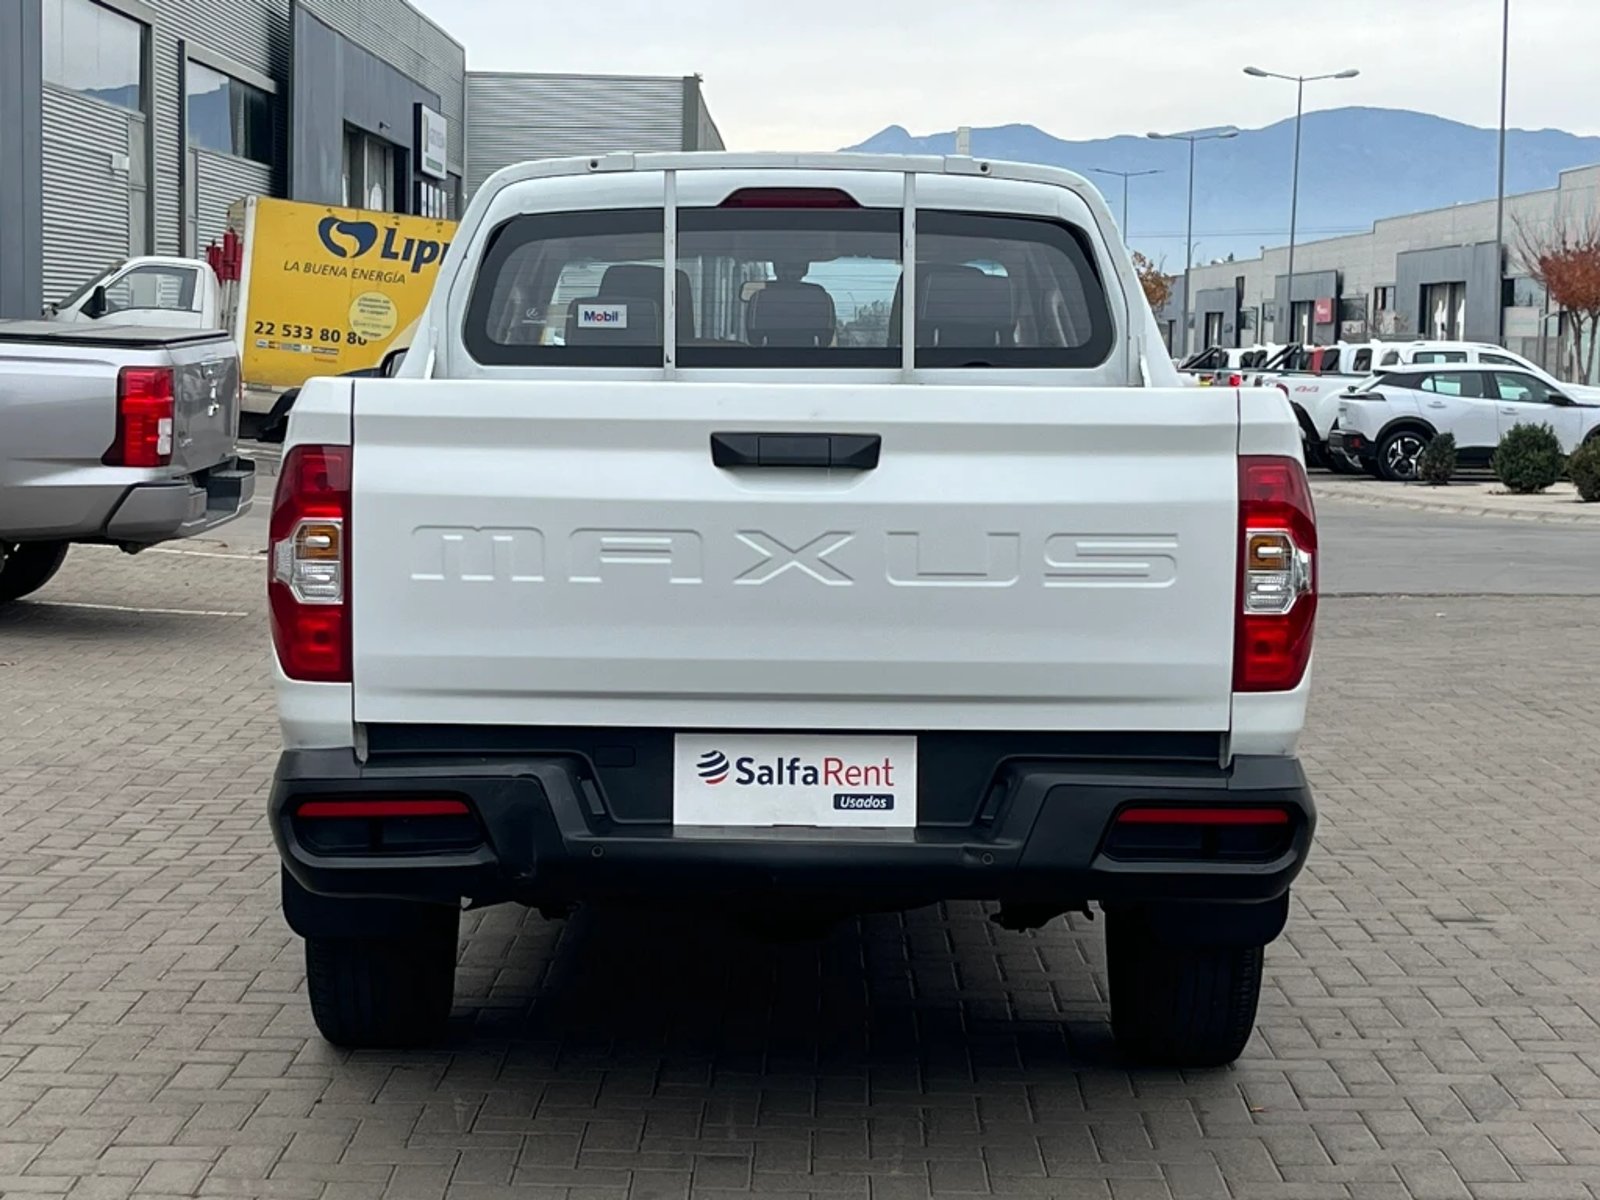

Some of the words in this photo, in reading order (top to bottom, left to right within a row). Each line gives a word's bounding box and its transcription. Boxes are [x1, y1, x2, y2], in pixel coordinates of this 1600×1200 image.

[284, 260, 300, 272] LA
[303, 263, 348, 278] BUENA
[352, 267, 406, 284] ENERGÍA
[584, 310, 619, 323] Mobil
[254, 321, 275, 336] 22
[281, 324, 313, 340] 533
[319, 328, 341, 343] 80
[410, 525, 1180, 589] MAXUS
[735, 756, 895, 787] SalfaRent
[840, 795, 888, 810] Usados
